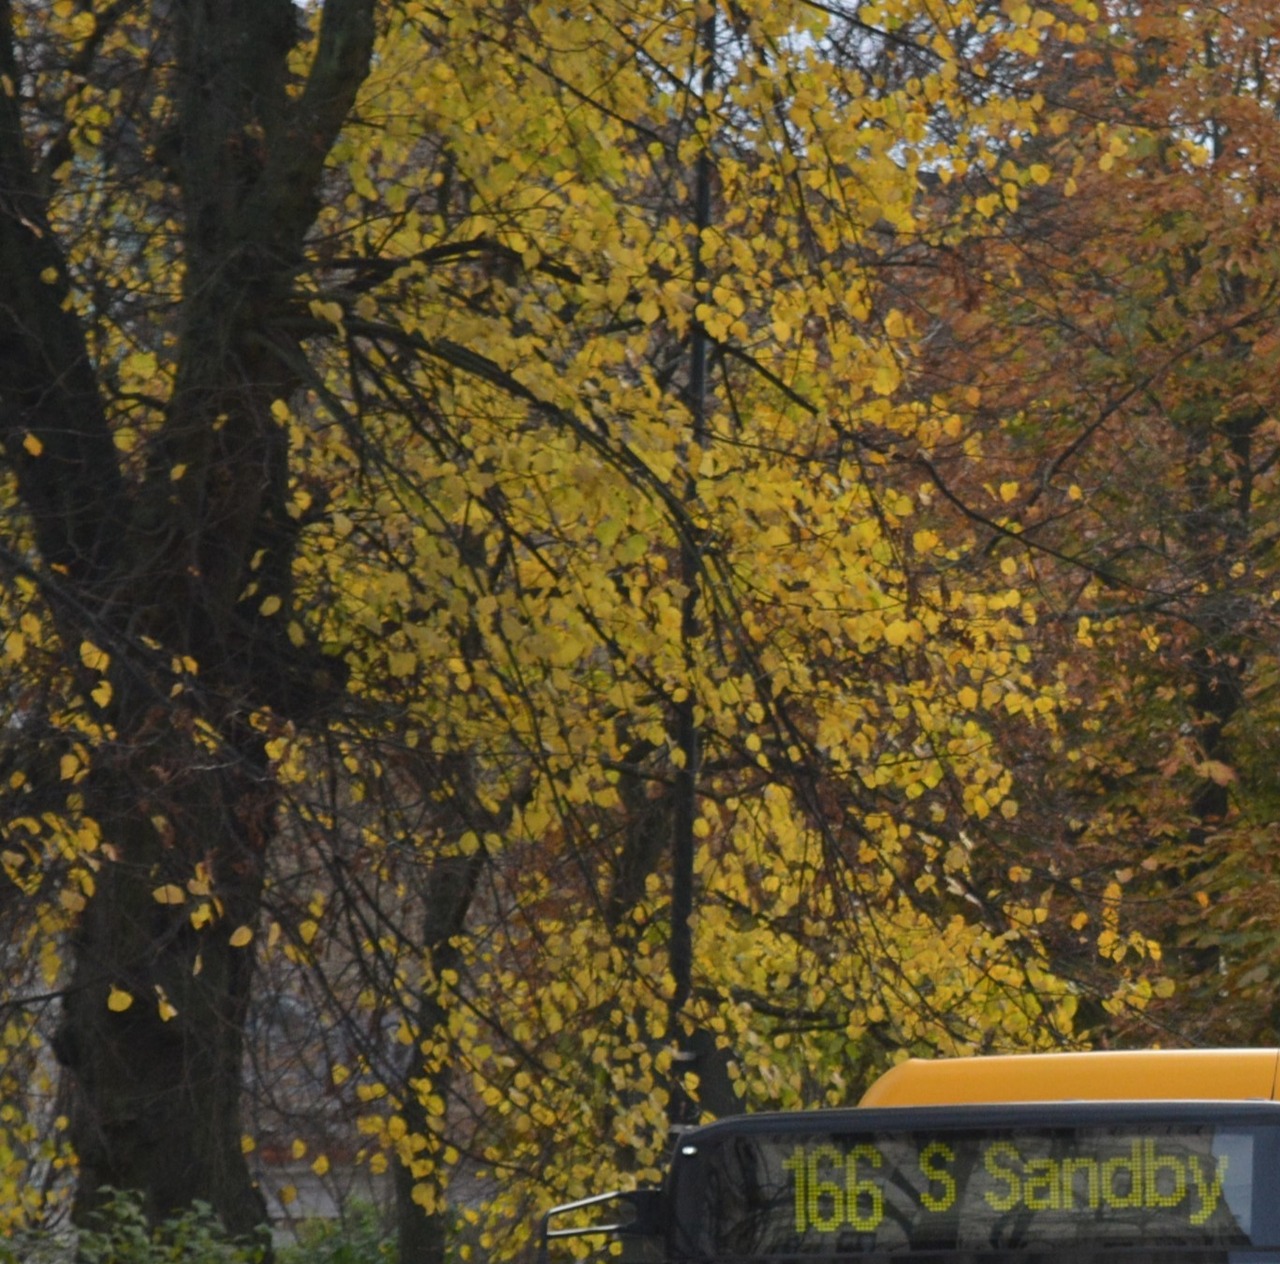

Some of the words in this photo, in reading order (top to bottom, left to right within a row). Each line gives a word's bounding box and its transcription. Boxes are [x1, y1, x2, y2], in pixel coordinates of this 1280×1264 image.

[782, 1143, 884, 1233] 166
[919, 1142, 957, 1213] S
[983, 1138, 1229, 1226] Sandby
